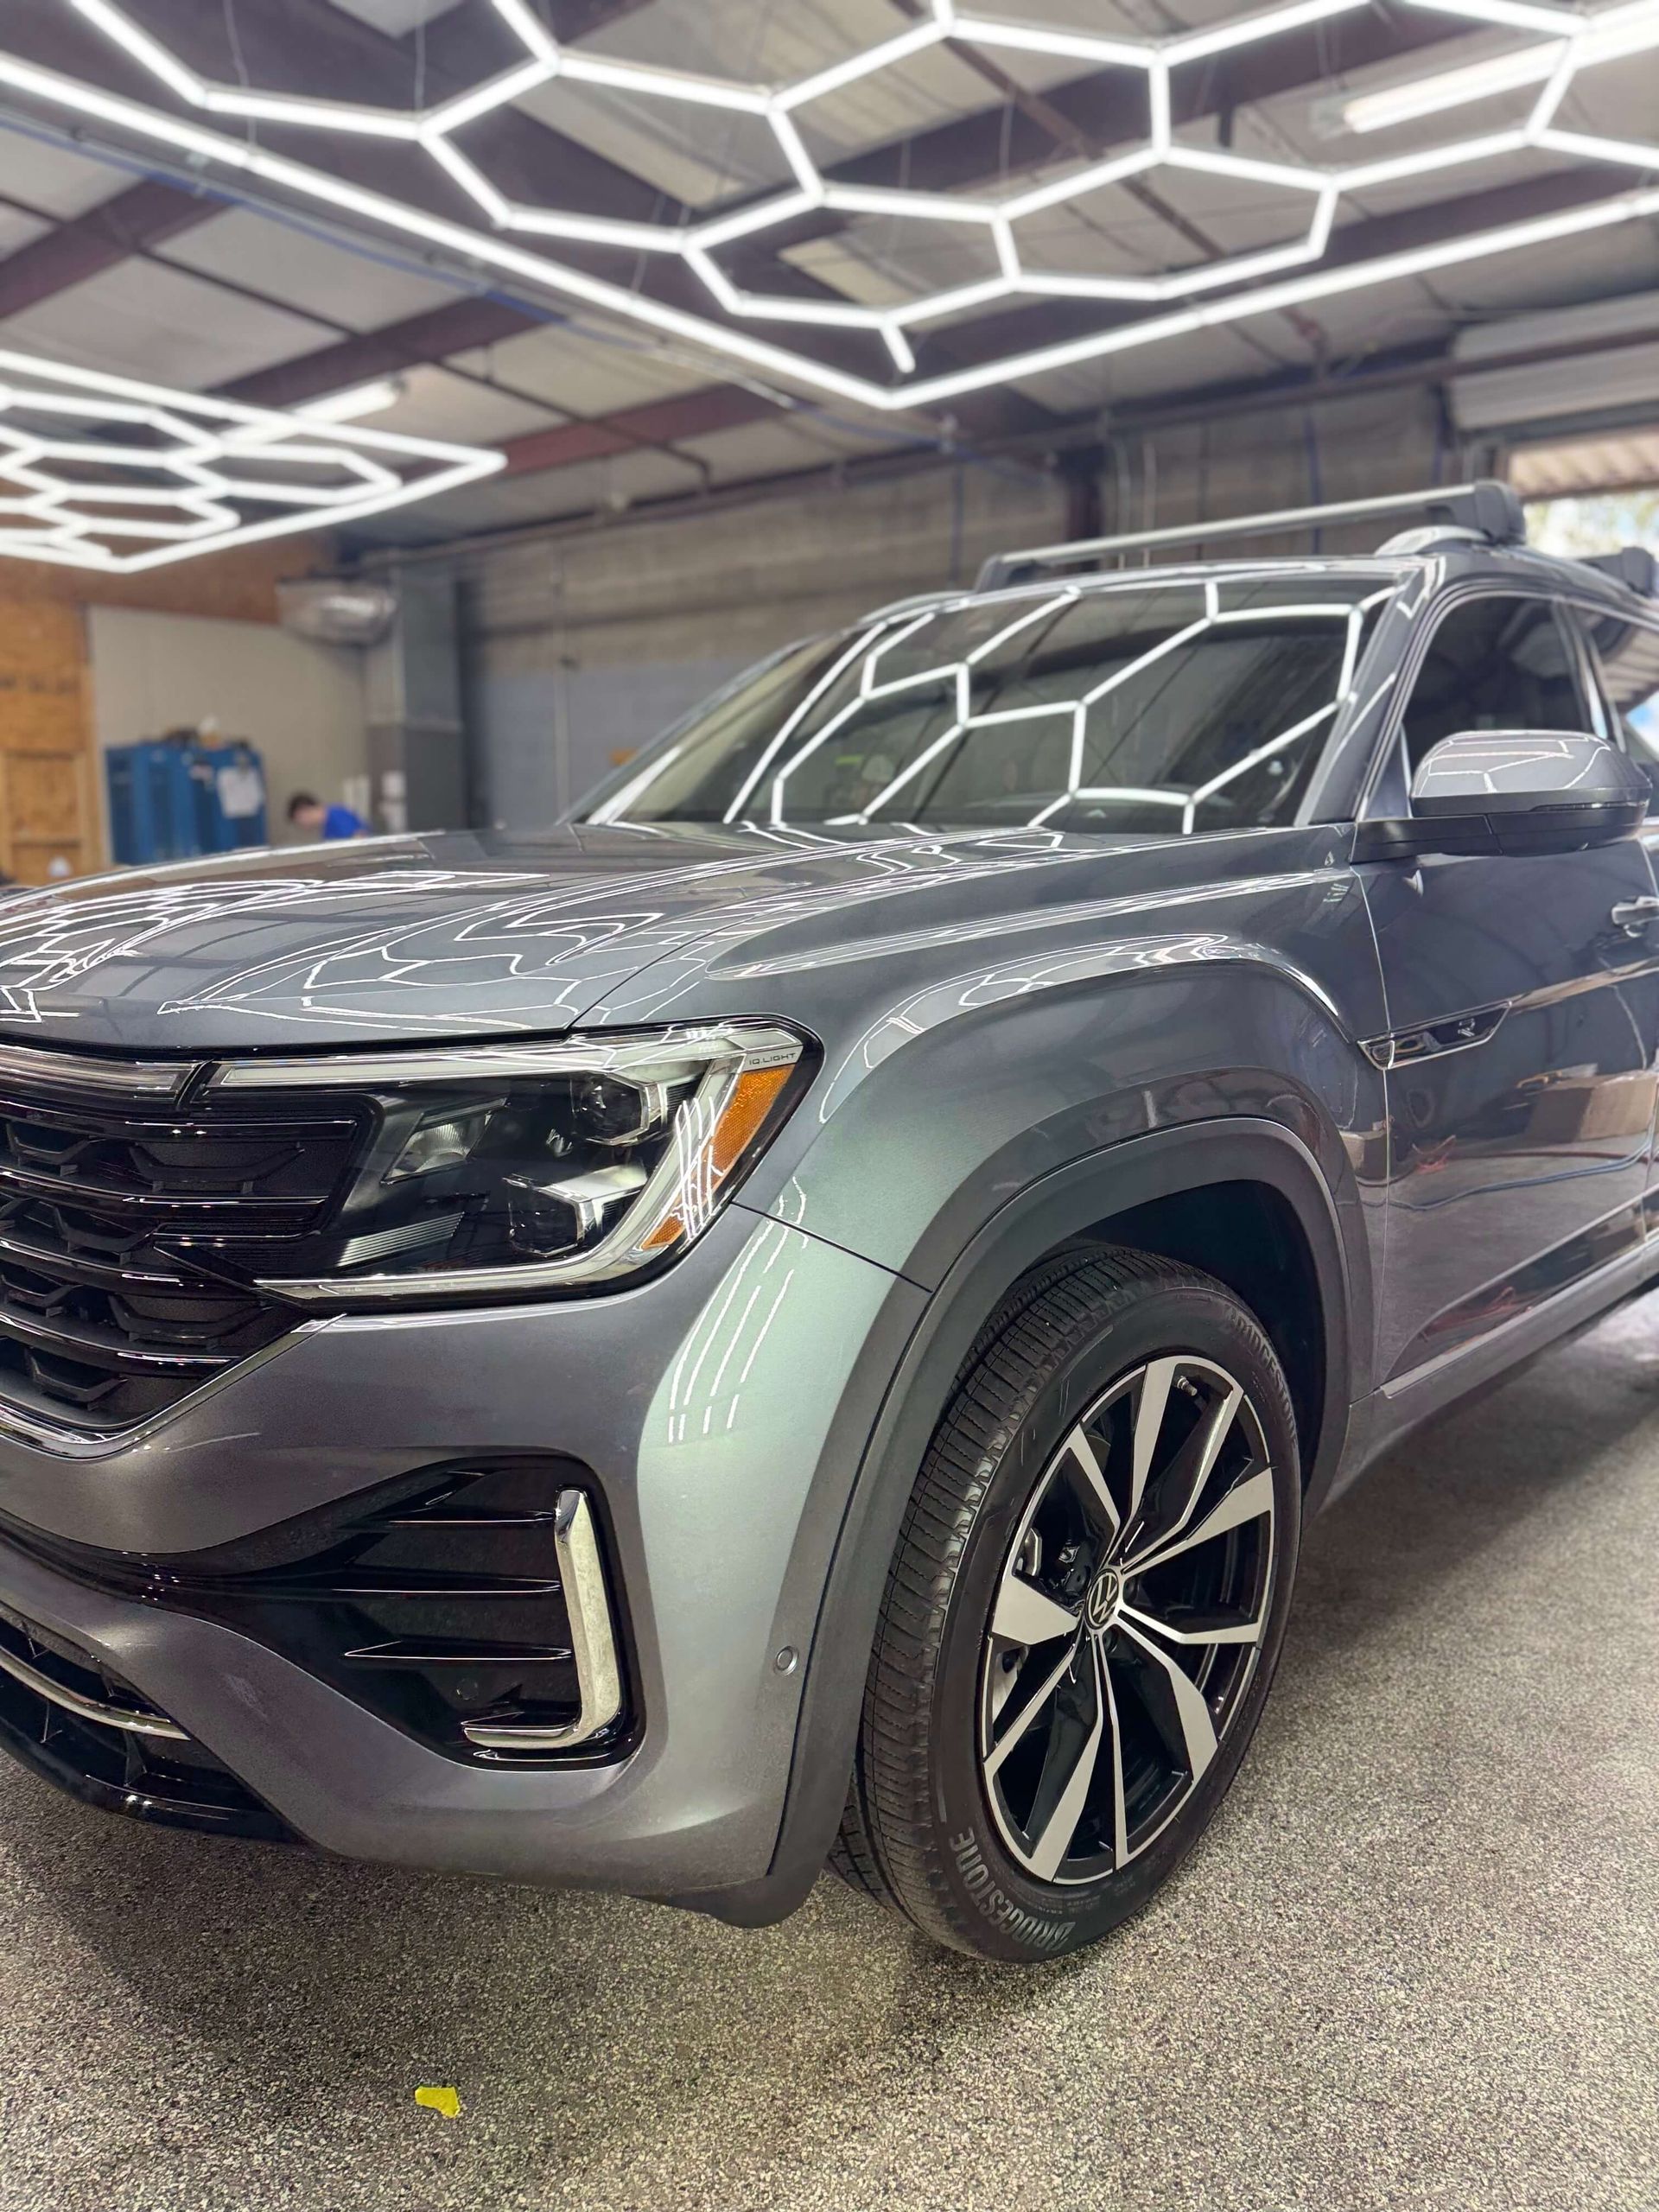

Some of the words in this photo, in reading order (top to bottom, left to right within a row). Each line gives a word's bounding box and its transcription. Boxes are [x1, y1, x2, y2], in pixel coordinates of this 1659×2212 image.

[749, 1052, 796, 1065] IQ.LIGHT
[1458, 1018, 1475, 1037] R
[1226, 1305, 1298, 1449] BRIDGESTONE
[950, 1827, 1076, 1951] BRIDGESTONE
